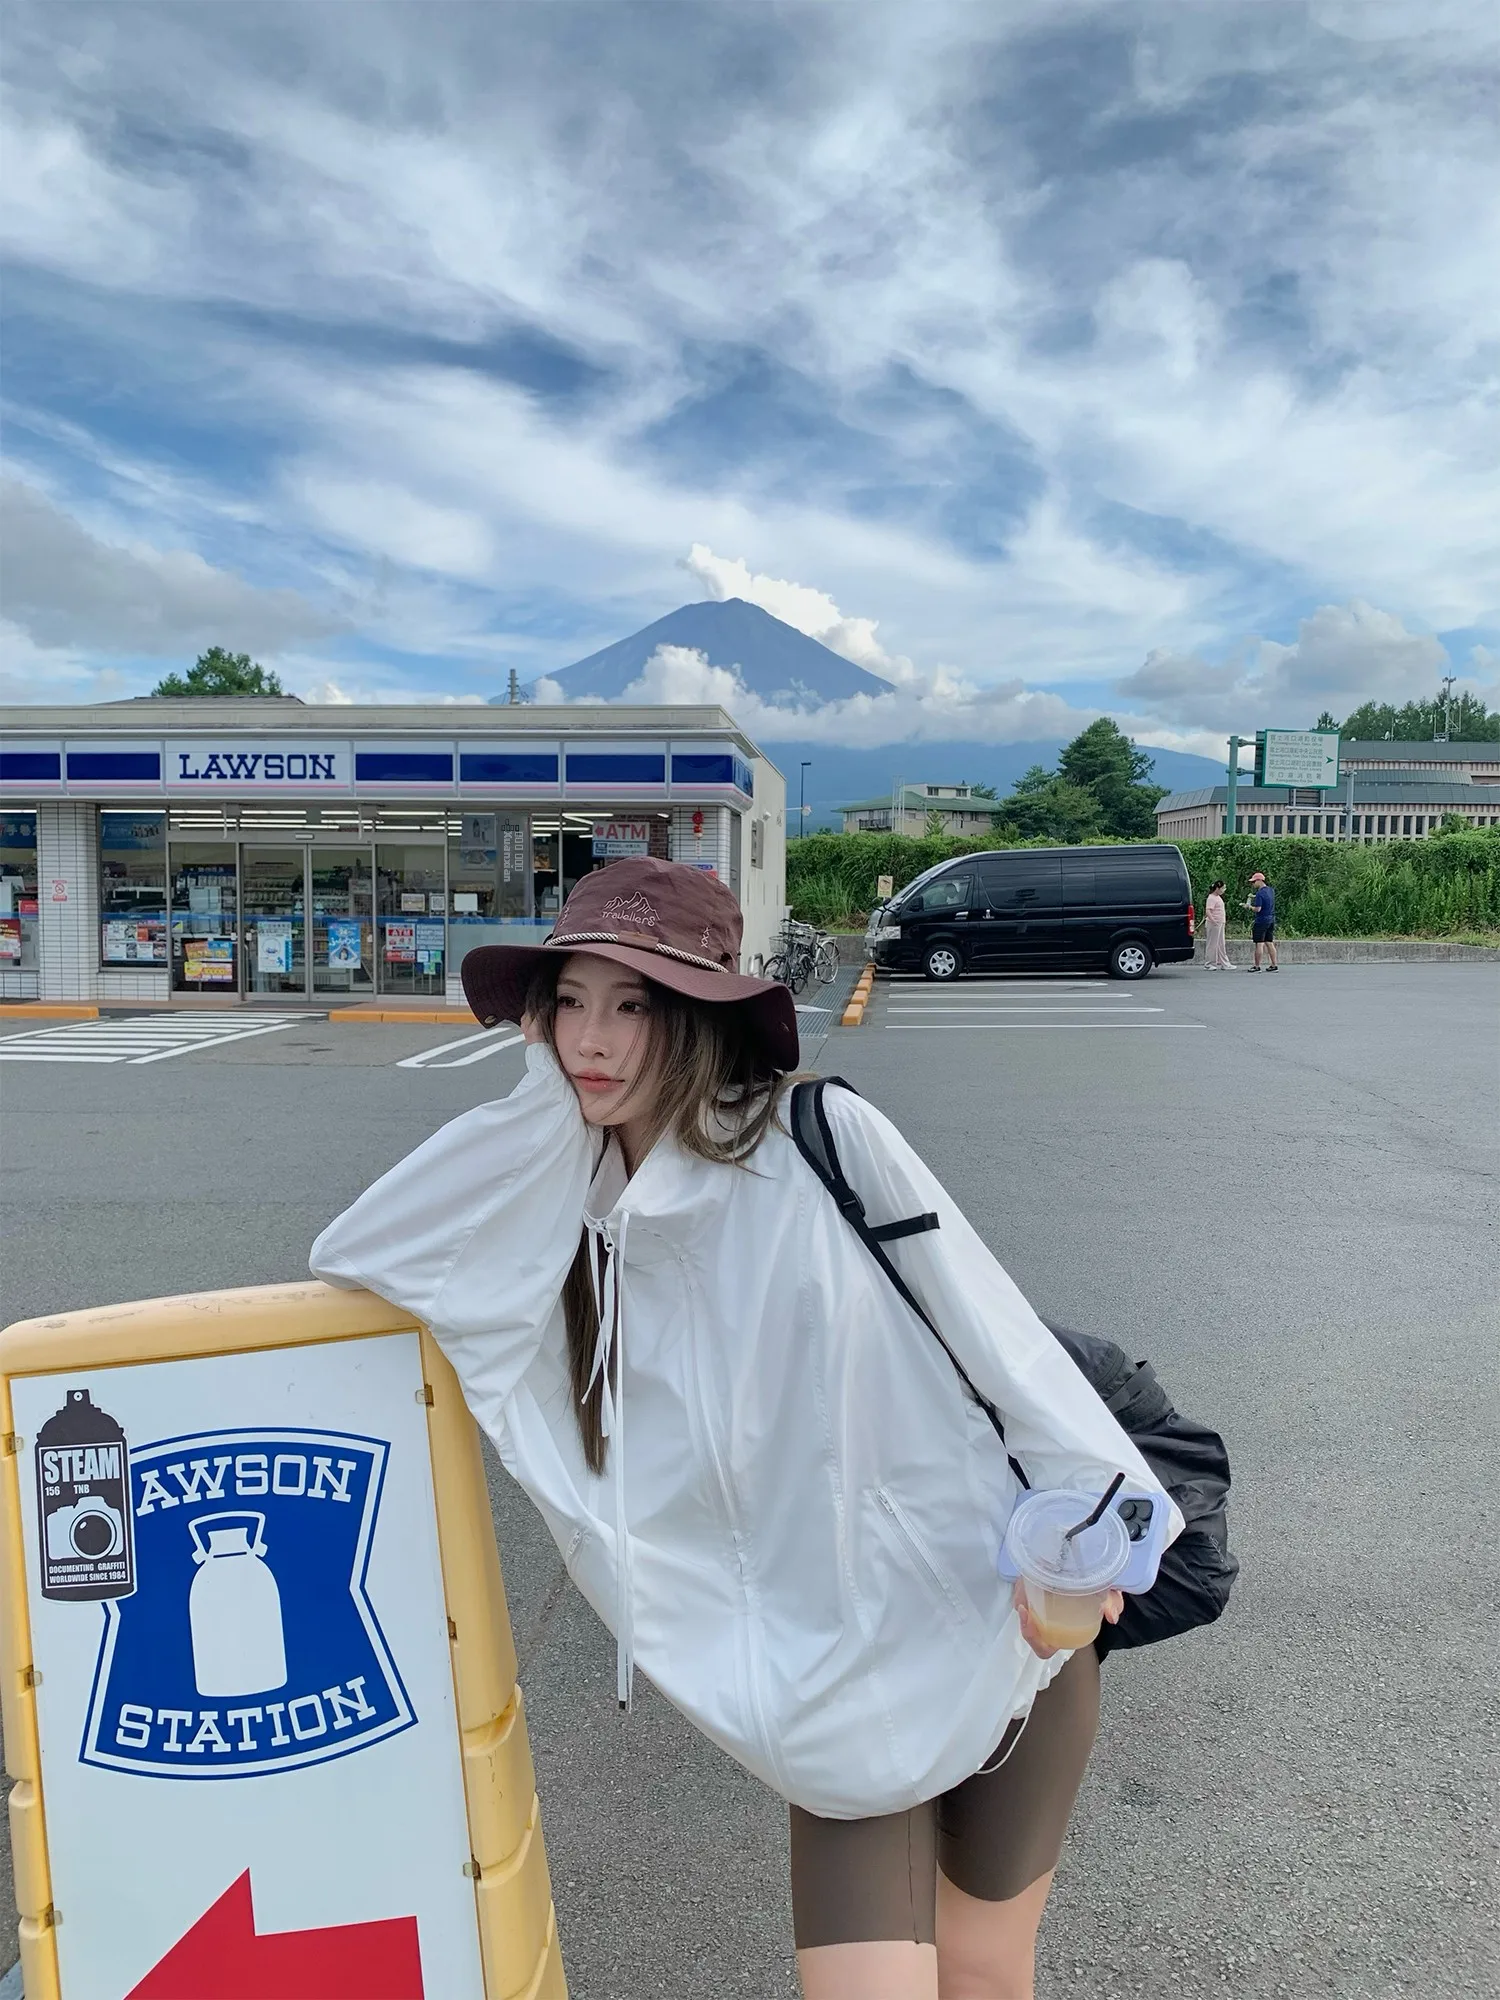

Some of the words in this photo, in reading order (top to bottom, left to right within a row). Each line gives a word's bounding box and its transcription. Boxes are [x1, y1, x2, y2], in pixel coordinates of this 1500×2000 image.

[179, 754, 336, 779] LAWSON
[606, 824, 646, 839] ATM
[43, 1447, 120, 1484] STEAM
[45, 1486, 61, 1496] 156
[73, 1484, 90, 1494] TNB
[136, 1454, 357, 1517] AWSON
[49, 1563, 94, 1574] DOCUMENTING
[97, 1561, 126, 1571] GRAFFITI
[49, 1573, 89, 1584] WORLDWIDE
[89, 1572, 108, 1582] SINCE
[109, 1570, 126, 1580] 1984
[116, 1676, 376, 1753] STATION
